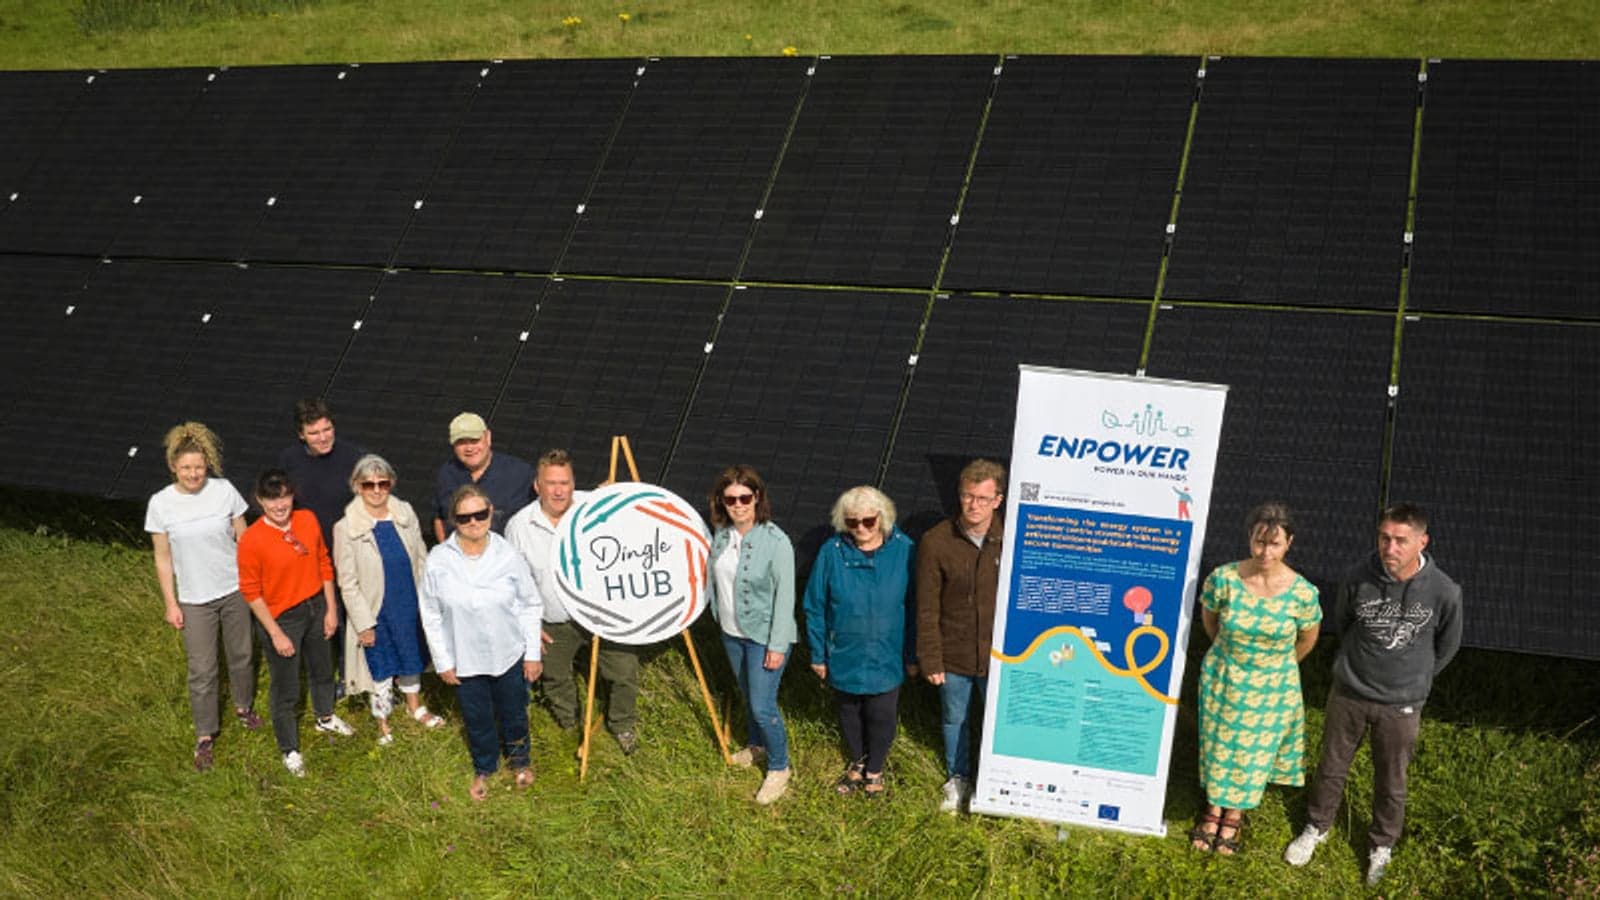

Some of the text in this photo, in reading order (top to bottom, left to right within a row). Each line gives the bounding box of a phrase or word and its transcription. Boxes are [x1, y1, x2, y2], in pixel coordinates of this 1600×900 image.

[1038, 434, 1190, 471] ENPOWER
[1094, 466, 1188, 482] POWER IN OUR HANDS
[589, 527, 672, 571] Dingle
[604, 570, 673, 601] HUB
